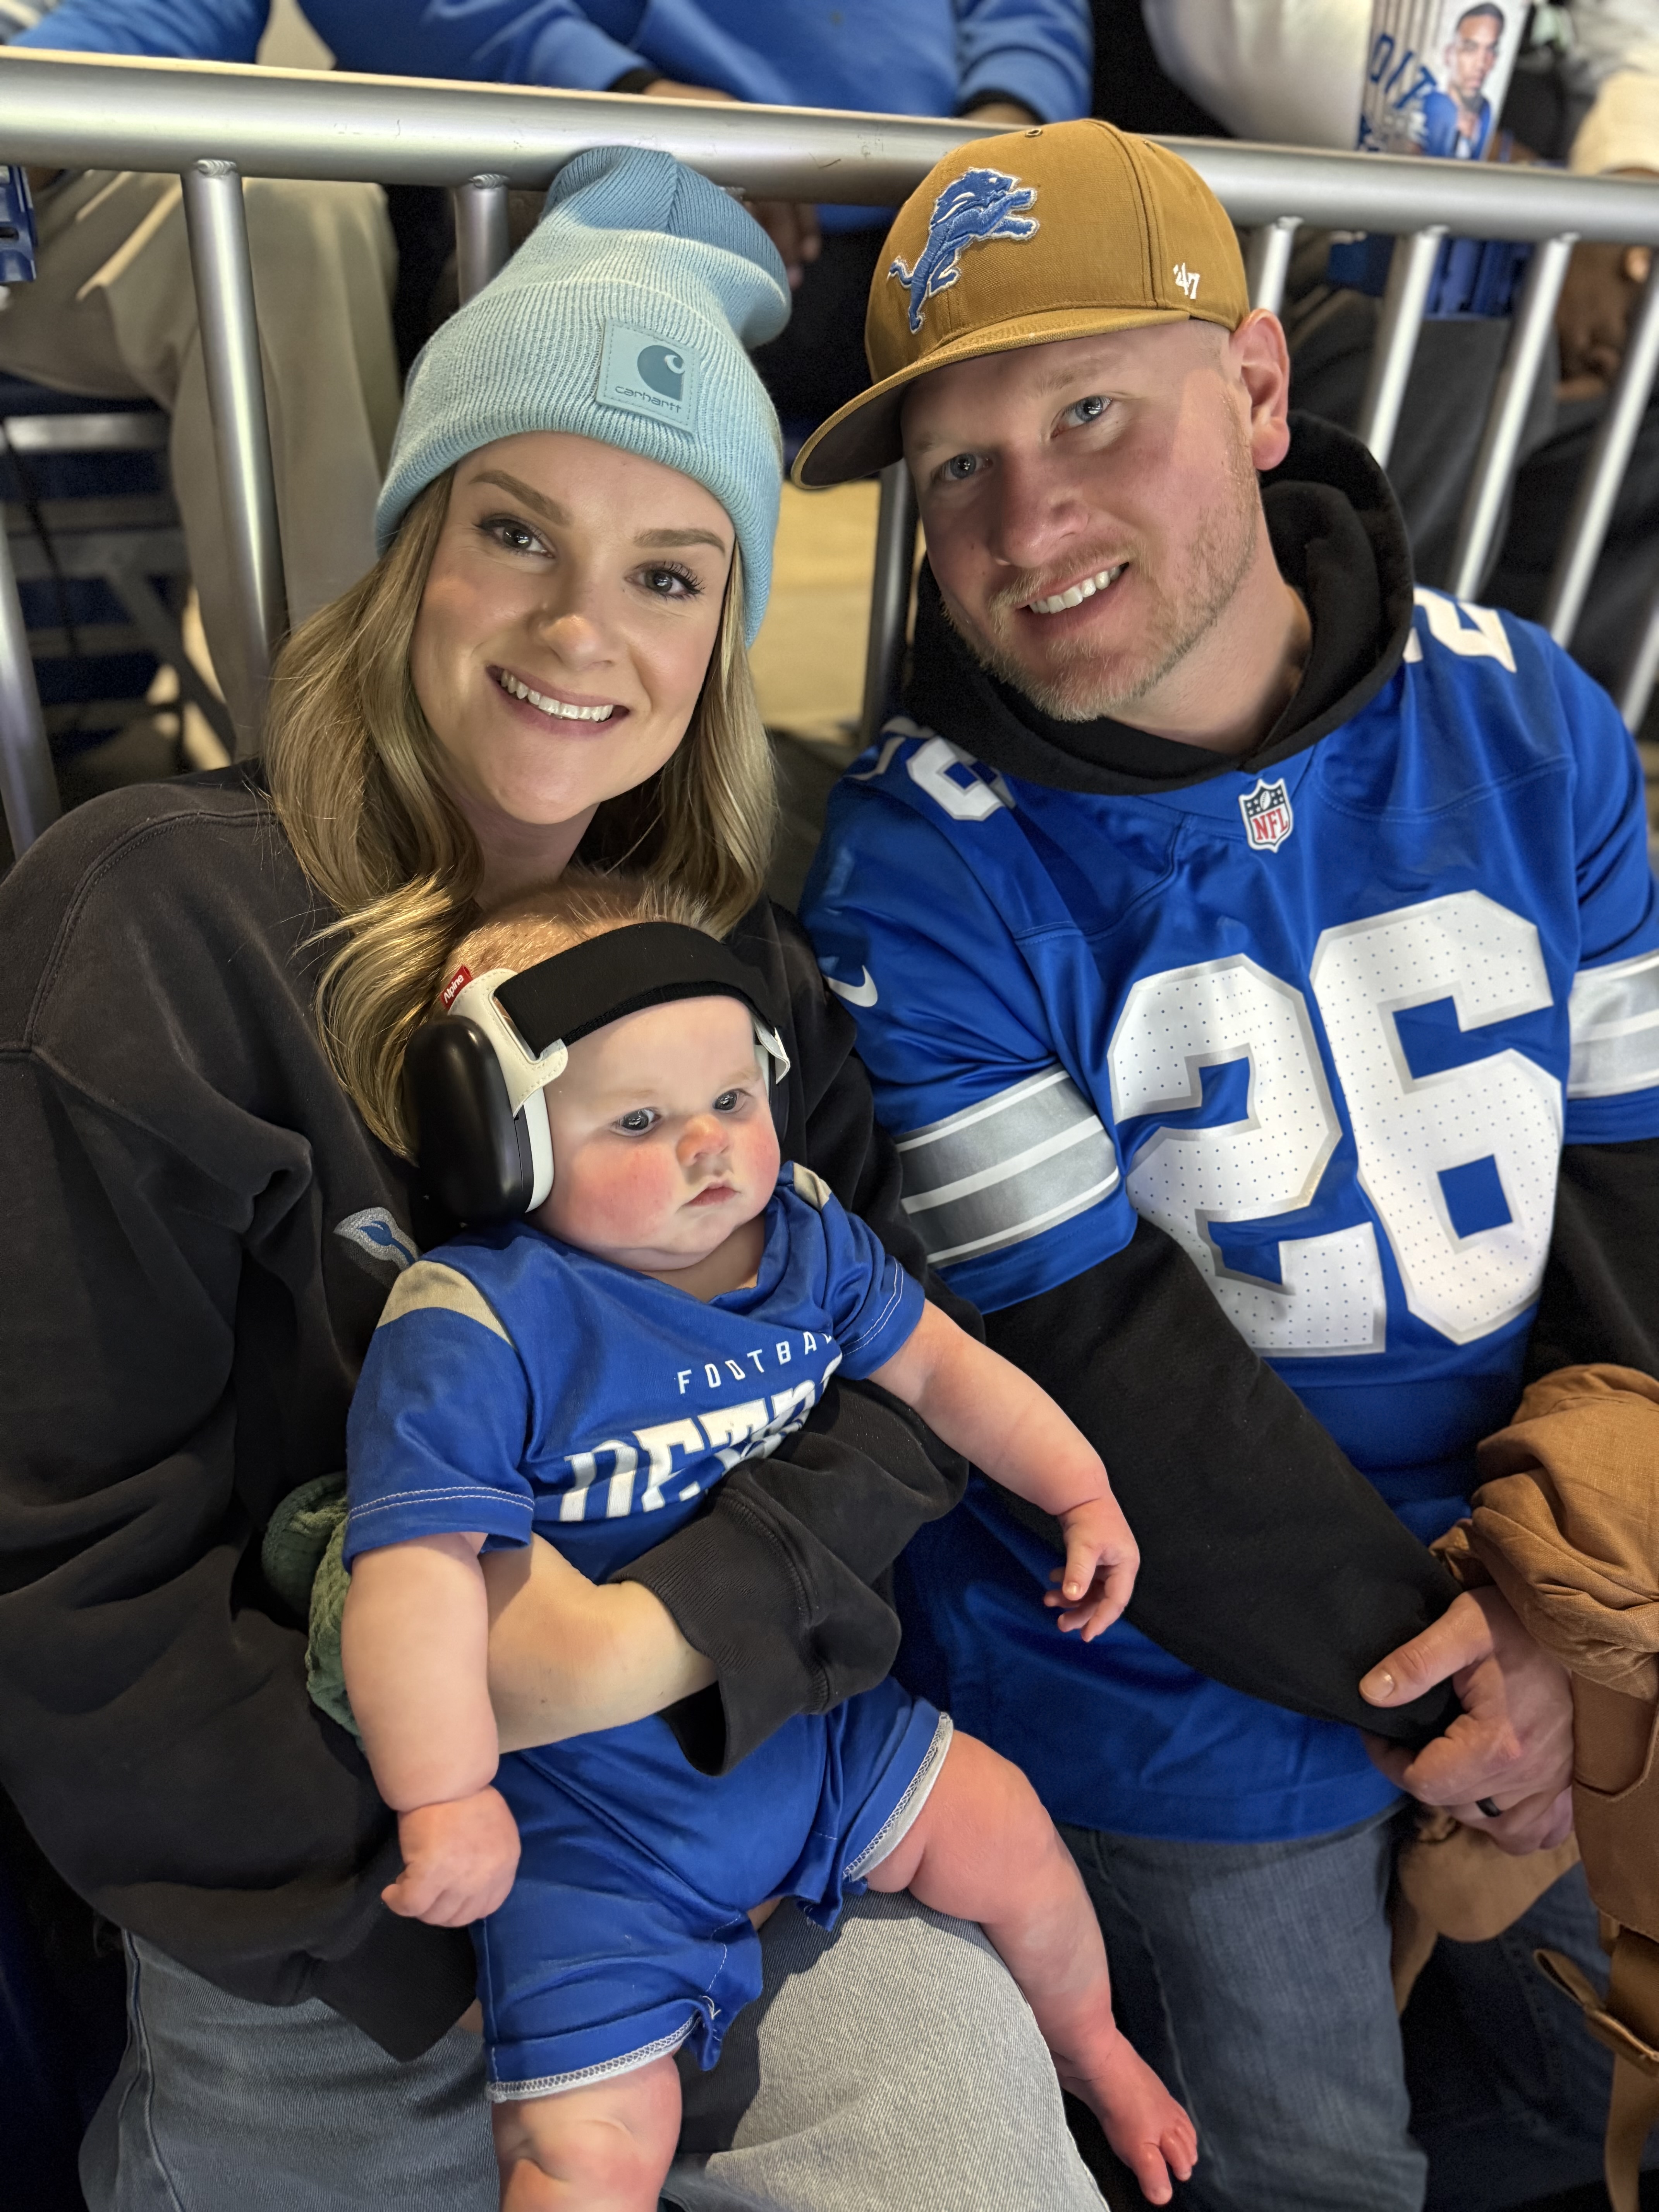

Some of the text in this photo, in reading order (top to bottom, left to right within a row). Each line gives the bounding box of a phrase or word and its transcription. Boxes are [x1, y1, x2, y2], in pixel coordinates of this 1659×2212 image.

[1252, 808, 1288, 840] NFL
[444, 974, 464, 1004] Alpine
[1107, 889, 1564, 1357] 26
